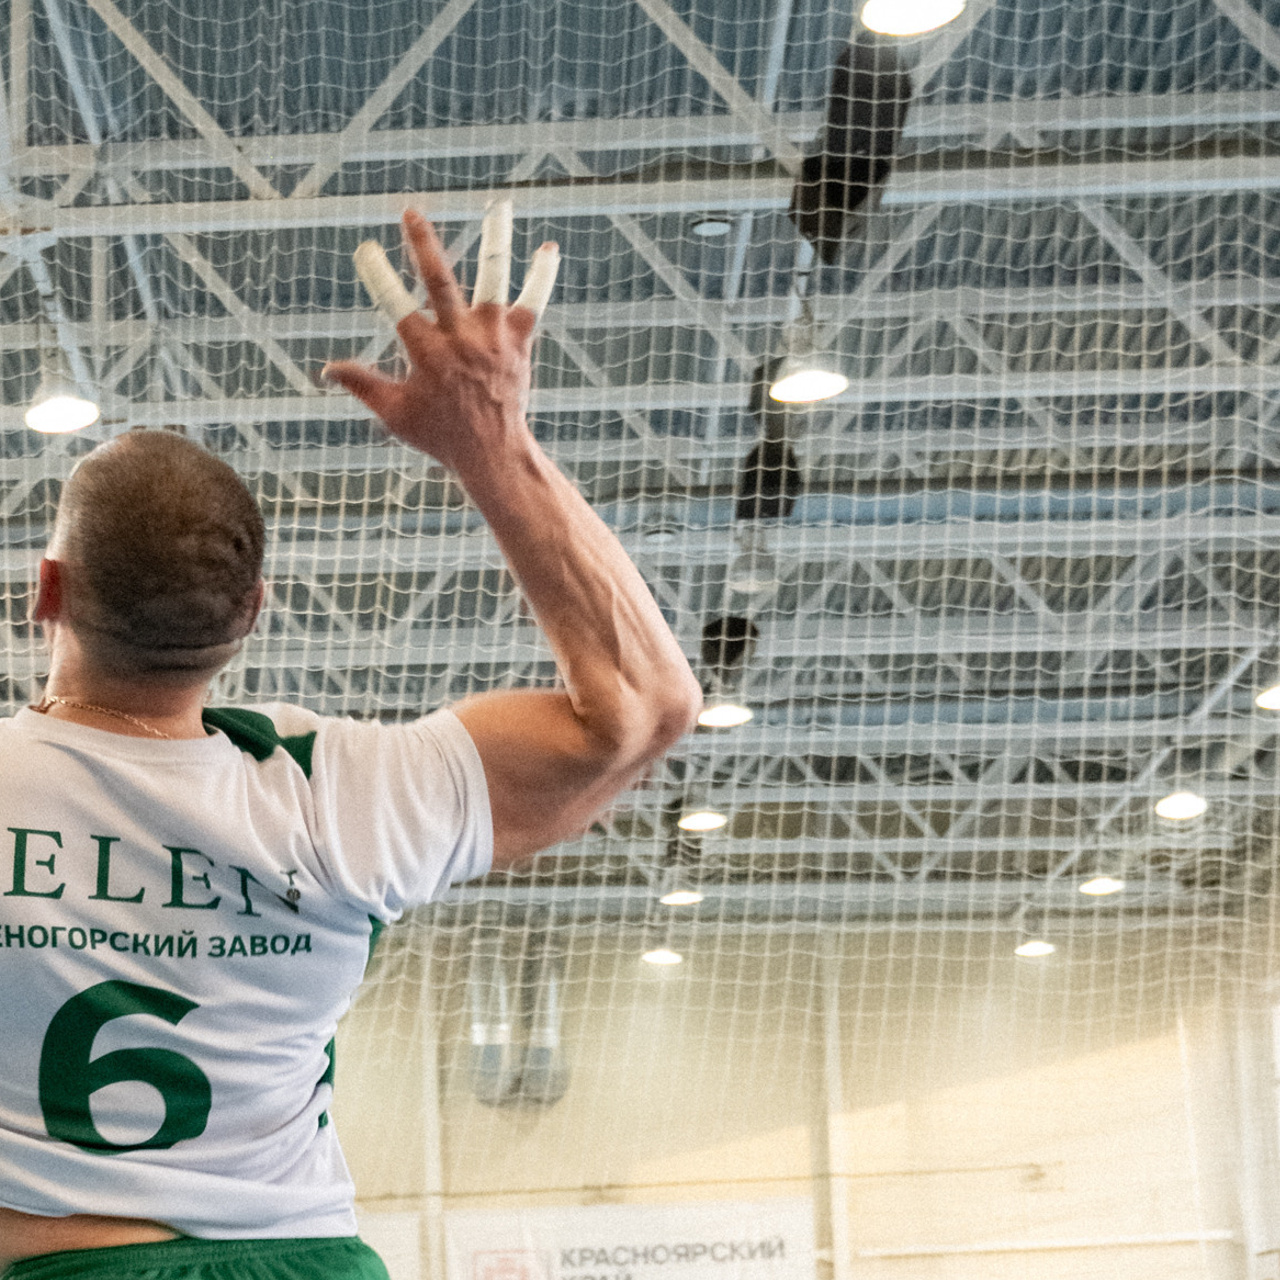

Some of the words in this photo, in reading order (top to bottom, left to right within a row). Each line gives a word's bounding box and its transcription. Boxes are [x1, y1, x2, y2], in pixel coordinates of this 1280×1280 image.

[207, 933, 312, 958] ЗАВОД
[39, 980, 212, 1155] 6
[560, 1236, 786, 1268] КРАСНОЯРСКИЙ
